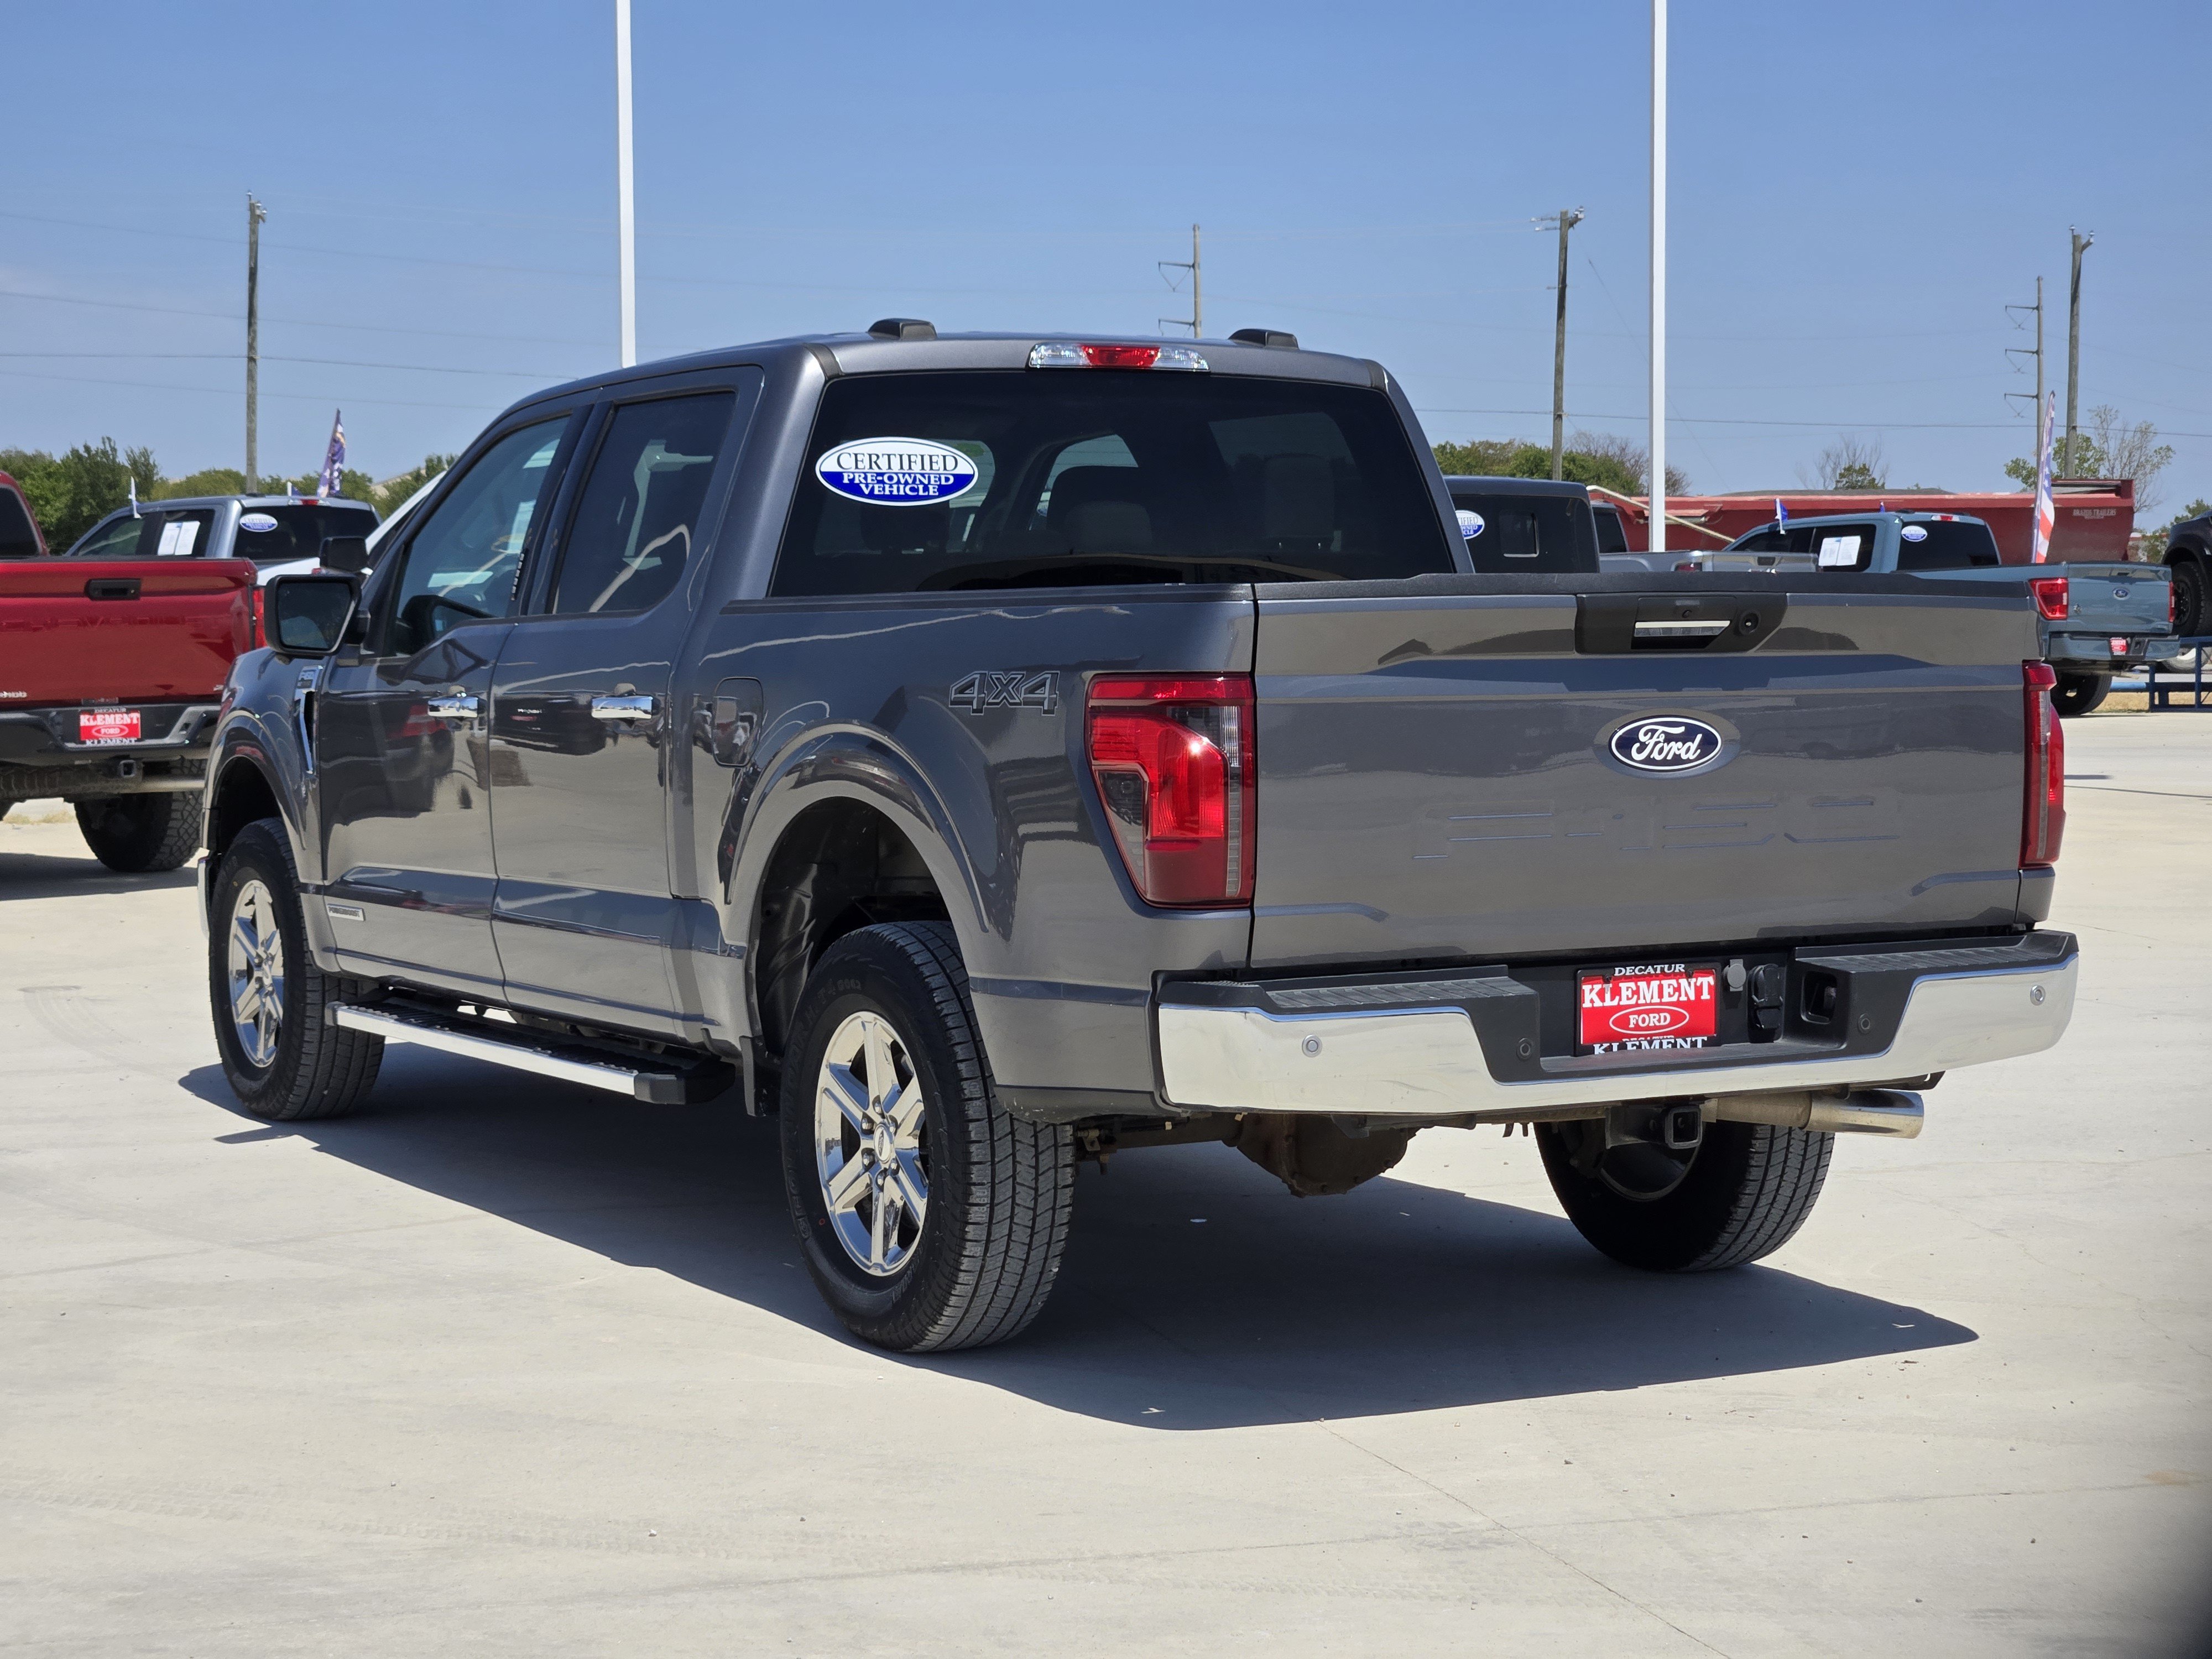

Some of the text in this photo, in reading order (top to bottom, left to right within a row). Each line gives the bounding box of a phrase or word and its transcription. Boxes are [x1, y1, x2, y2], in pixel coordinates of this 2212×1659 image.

[837, 452, 958, 471] CERTIFIED
[842, 473, 954, 485] PRE-OWNED
[859, 484, 939, 495] VEHICLE
[80, 713, 140, 726] KLEMENT
[1631, 725, 1702, 760] Ford
[1614, 964, 1686, 976] DECATUR
[1582, 976, 1714, 1008] KLEMENT
[1629, 1013, 1671, 1028] FORD
[1593, 1036, 1708, 1055] KLEMENT
